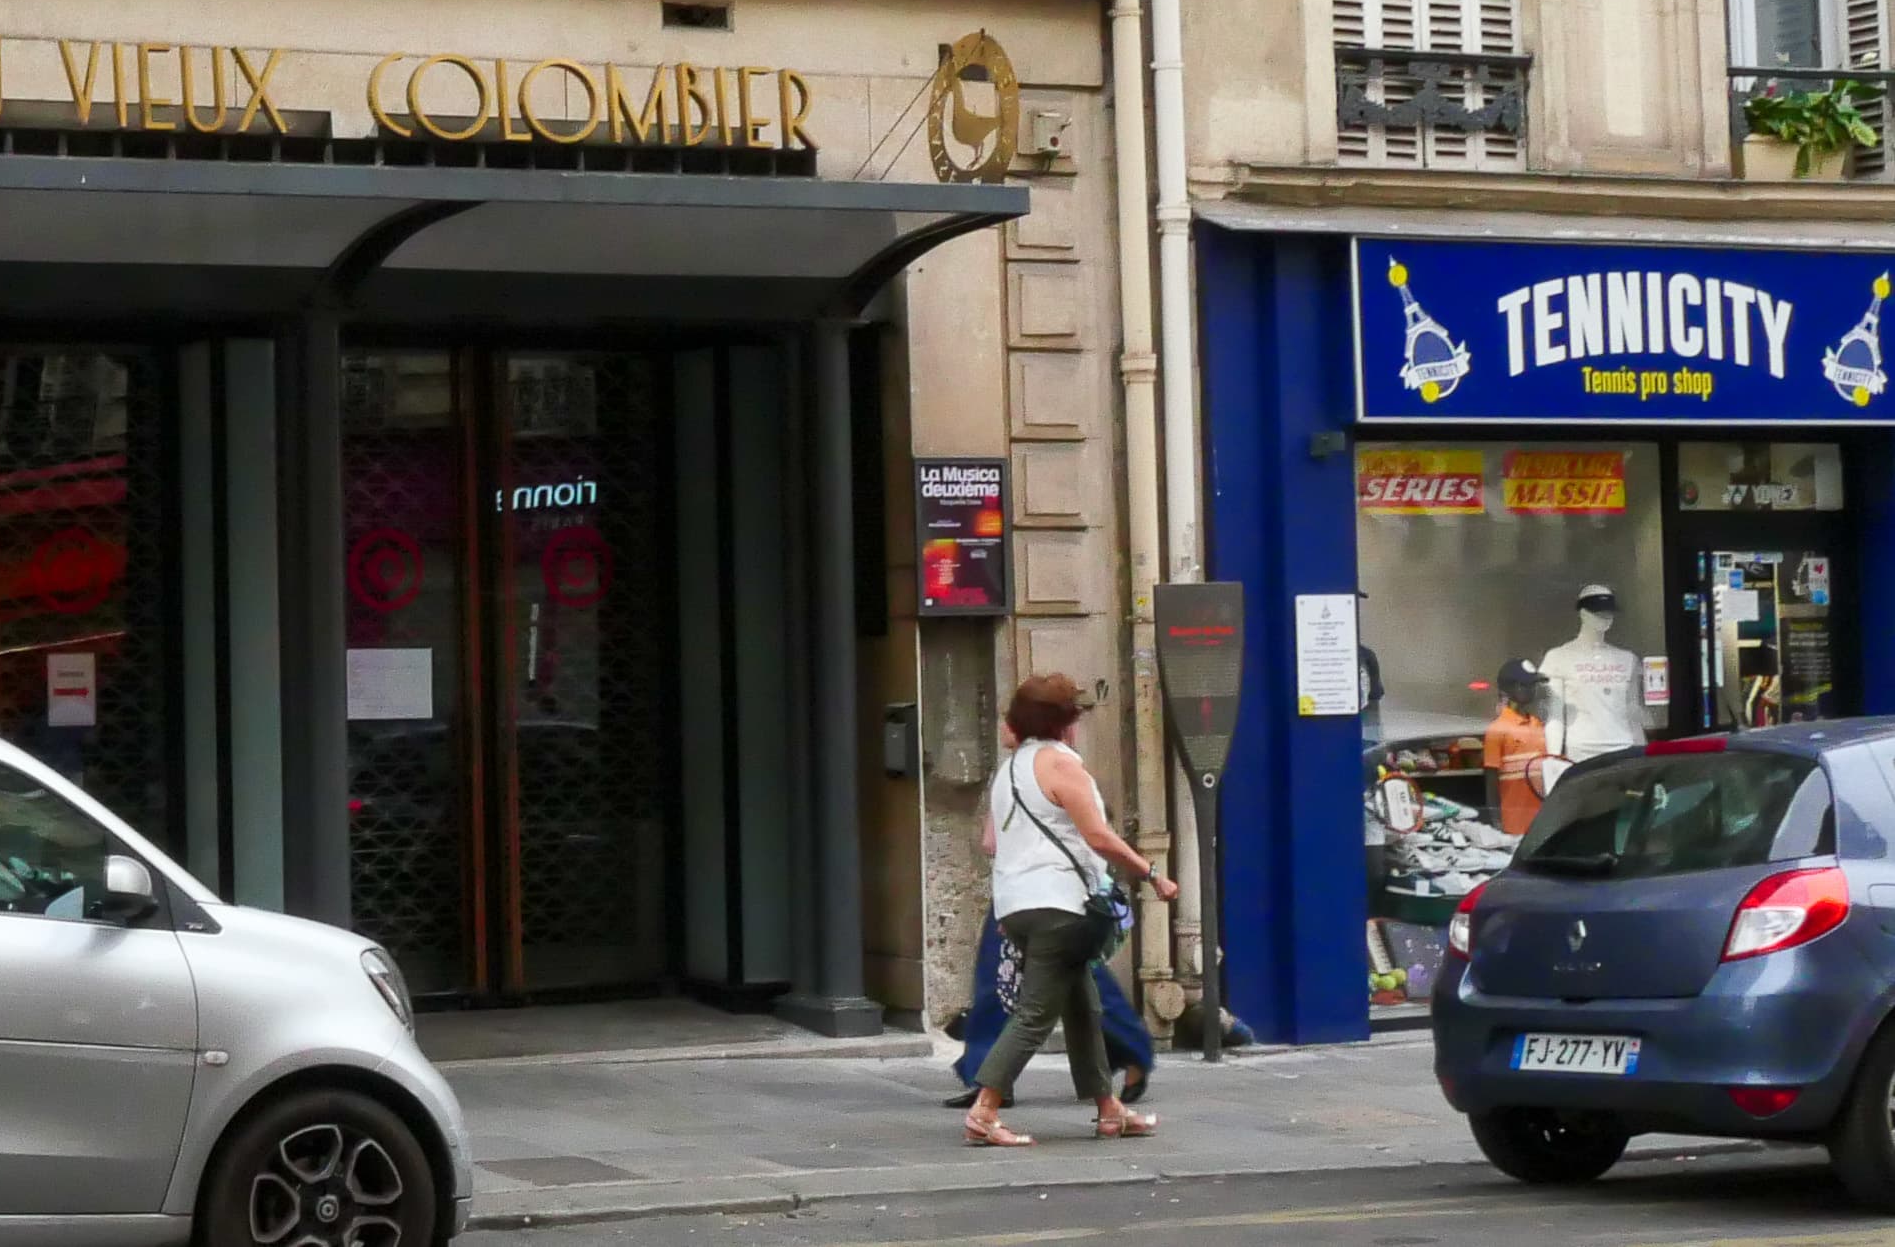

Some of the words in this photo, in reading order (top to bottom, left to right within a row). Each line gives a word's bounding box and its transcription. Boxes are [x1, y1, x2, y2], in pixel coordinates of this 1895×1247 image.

[57, 38, 291, 134] VIEUX
[367, 52, 819, 151] COLOMBIER
[1497, 271, 1793, 380] TENNICITY
[1582, 366, 1637, 395] Tennis
[1640, 372, 1669, 402] pro
[1673, 368, 1712, 402] shop
[921, 466, 940, 482] La
[943, 466, 1000, 482] Musica
[1513, 481, 1619, 506] MASSIF
[1525, 1038, 1625, 1067] FJ-277-YV
